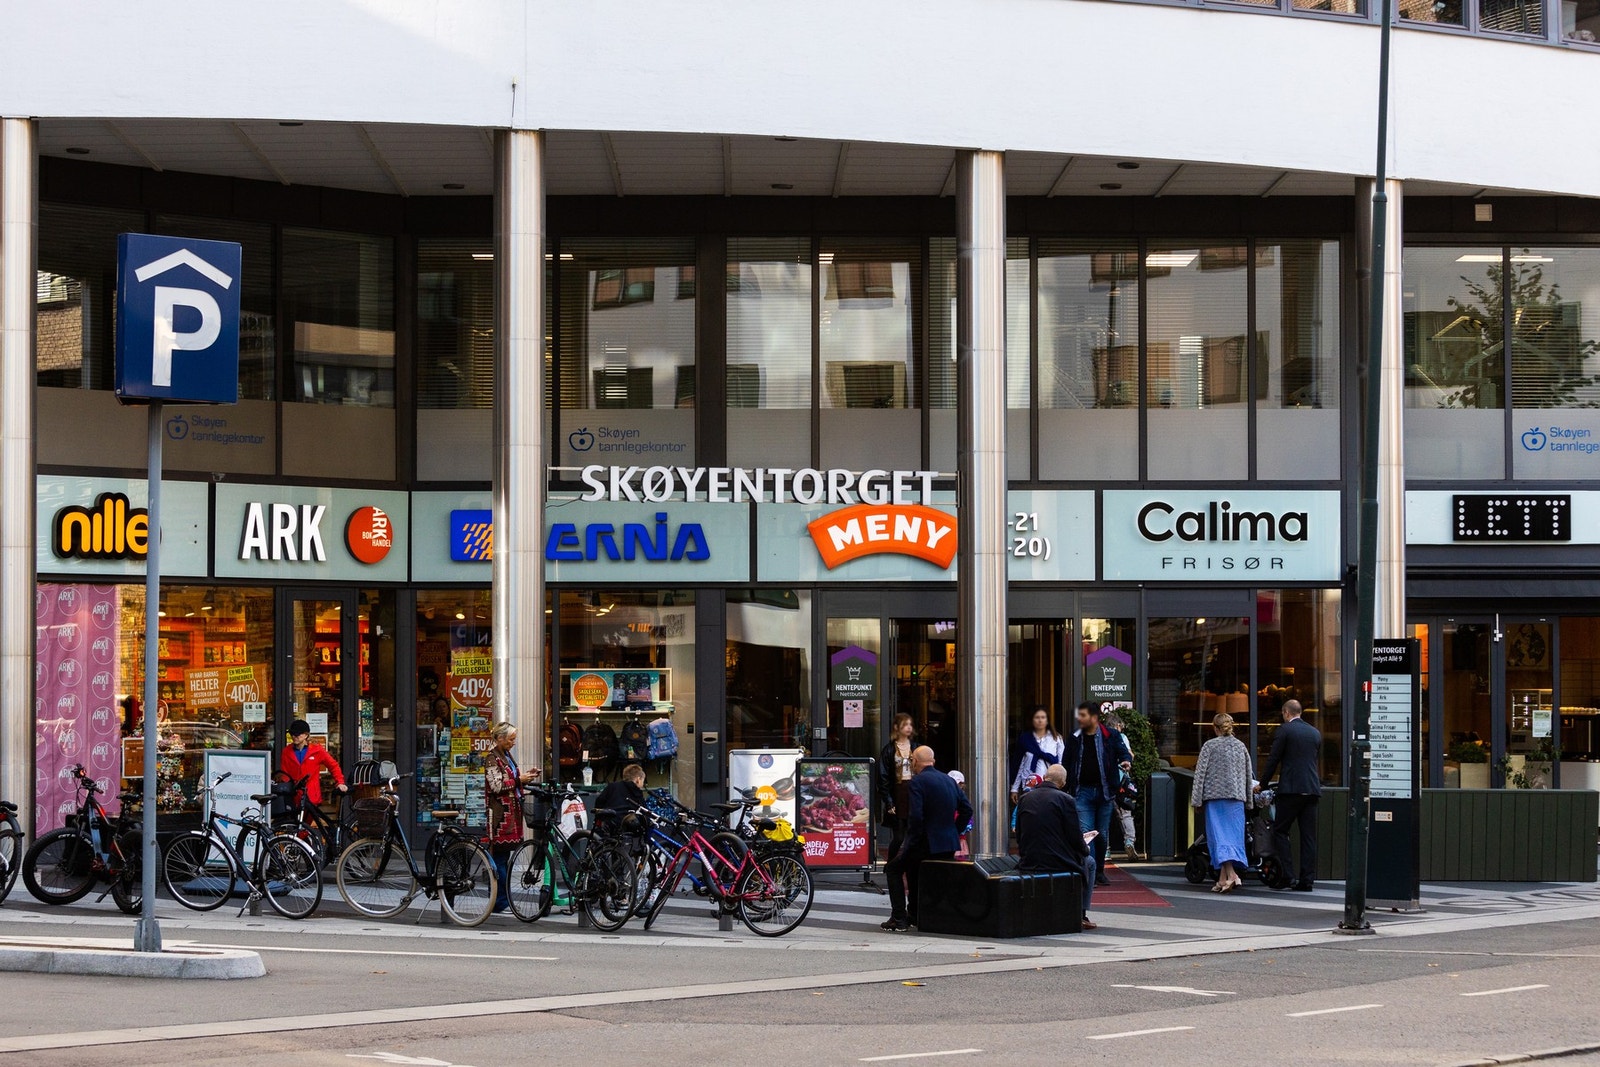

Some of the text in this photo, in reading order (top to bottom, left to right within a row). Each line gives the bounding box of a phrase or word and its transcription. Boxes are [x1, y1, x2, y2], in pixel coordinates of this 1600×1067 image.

[152, 285, 222, 387] P
[191, 414, 227, 429] Skøyen
[191, 431, 265, 445] tannlegekontor
[598, 426, 640, 440] Skøyen
[1549, 426, 1591, 442] Skøyen
[598, 441, 687, 455] tannlegekontor
[1550, 440, 1600, 454] tannlege
[580, 464, 939, 506] SKØYENTORGET
[60, 497, 149, 554] nille
[372, 506, 388, 539] ARK
[1007, 512, 1038, 531] -21
[1137, 500, 1309, 542] Calima
[1458, 499, 1566, 536] LETT
[240, 502, 327, 562] ARK
[361, 531, 374, 540] BOK
[545, 511, 711, 561] ERNIA
[827, 513, 952, 552] MENY
[371, 538, 392, 548] HANDEL
[1007, 536, 1052, 561] -20)
[1161, 556, 1285, 570] FRISØR
[934, 621, 955, 634] ME
[456, 659, 469, 667] ALLE
[470, 658, 485, 666] SPILL
[190, 678, 219, 692] HELTER
[452, 678, 492, 698] -40%
[226, 684, 257, 703] -40%
[804, 840, 829, 849] ENDELIG
[806, 848, 827, 857] HELG!
